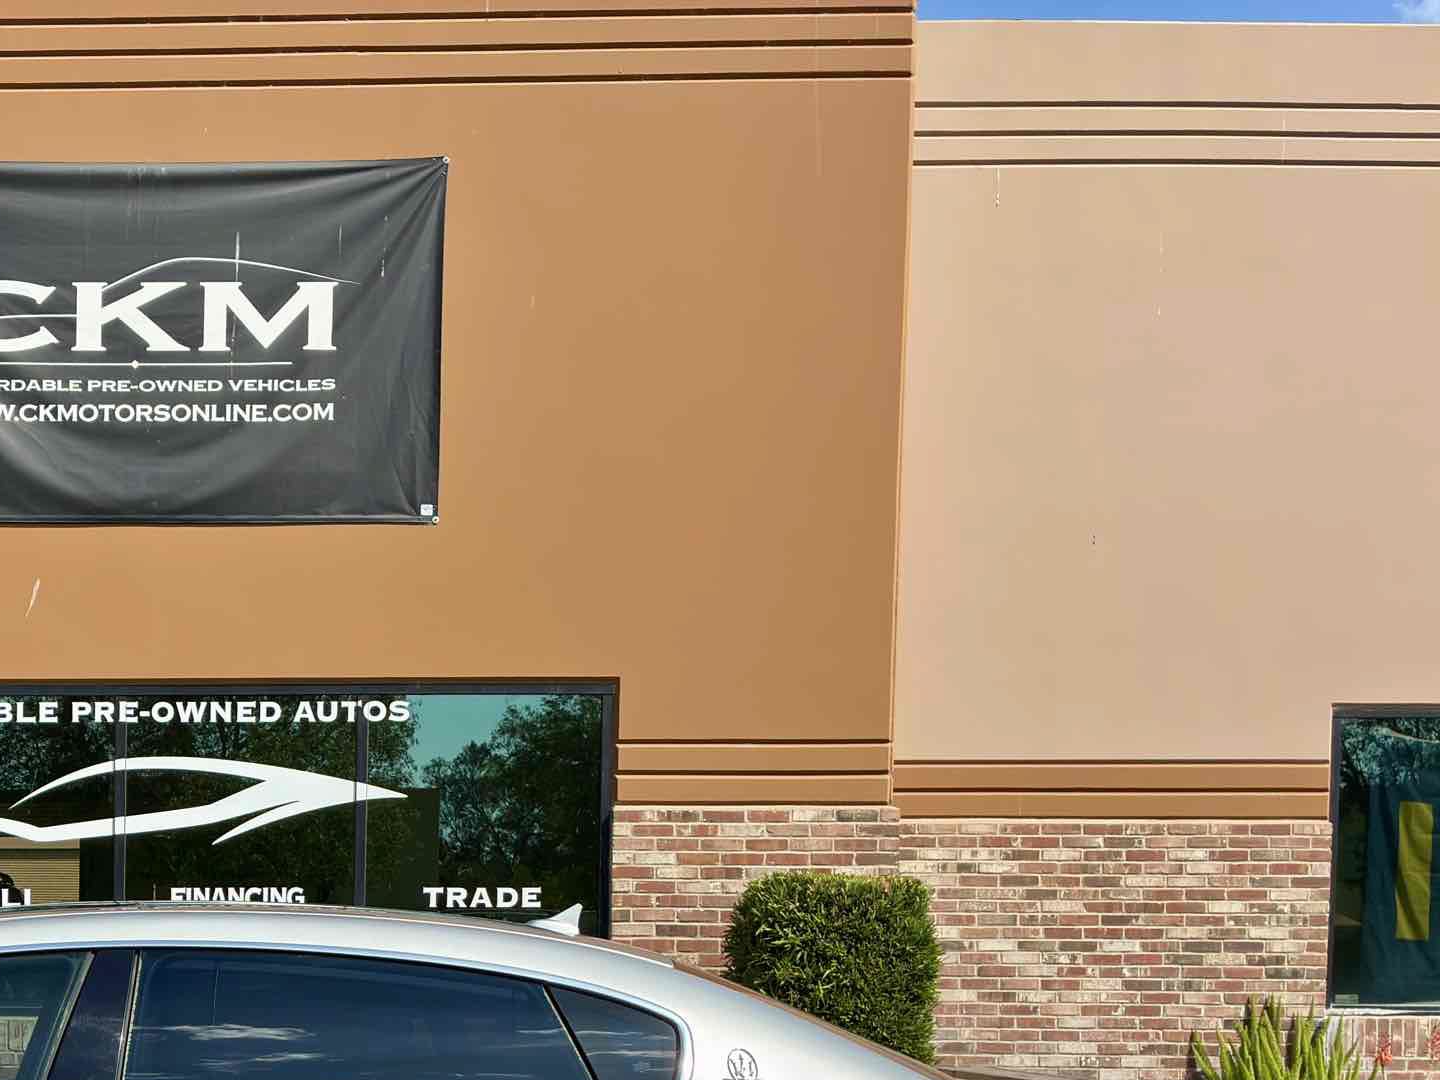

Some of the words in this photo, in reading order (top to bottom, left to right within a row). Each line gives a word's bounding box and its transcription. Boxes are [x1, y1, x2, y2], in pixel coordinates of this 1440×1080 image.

[87, 379, 223, 393] PRE-OWNED
[228, 378, 337, 393] VEHICLES
[71, 700, 282, 724] PRE-OWNED
[294, 699, 411, 723] AUTOS
[170, 886, 305, 903] FINANCING
[422, 886, 542, 908] TRADE
